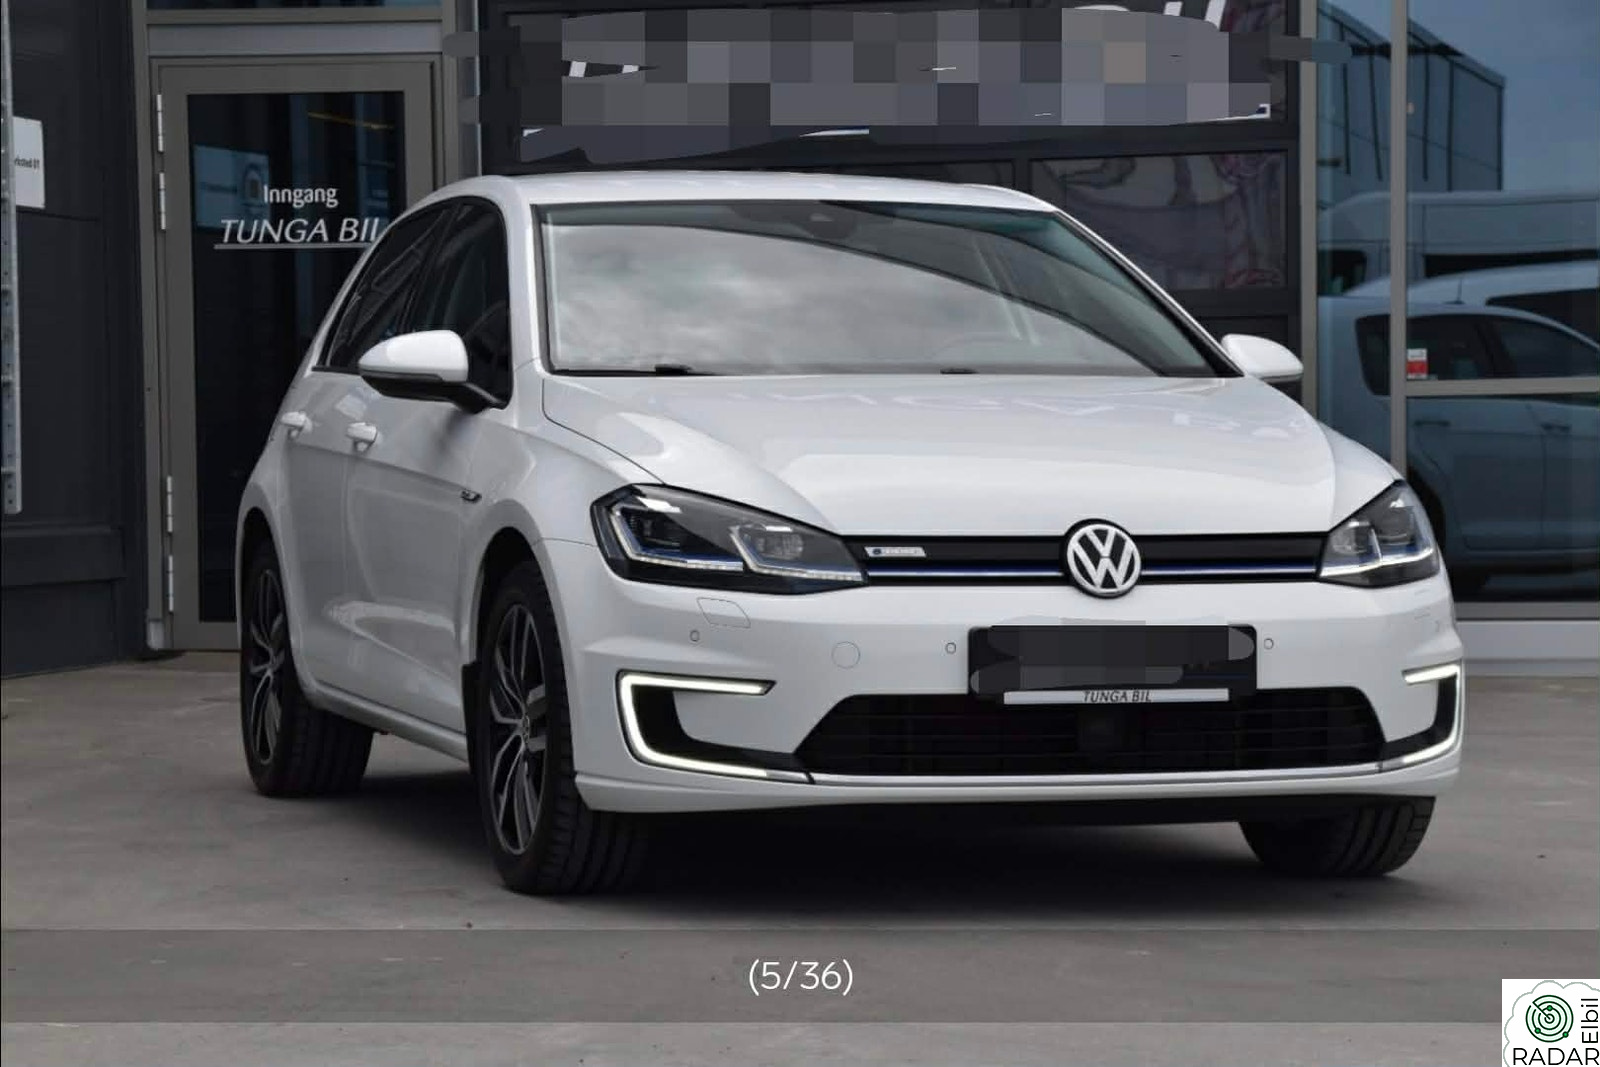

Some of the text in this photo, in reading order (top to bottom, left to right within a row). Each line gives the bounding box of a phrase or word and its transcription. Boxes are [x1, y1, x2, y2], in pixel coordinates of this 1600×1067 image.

[263, 184, 339, 208] Inngang
[220, 218, 329, 243] TUNGA
[1083, 690, 1152, 702] TUNGA BIL
